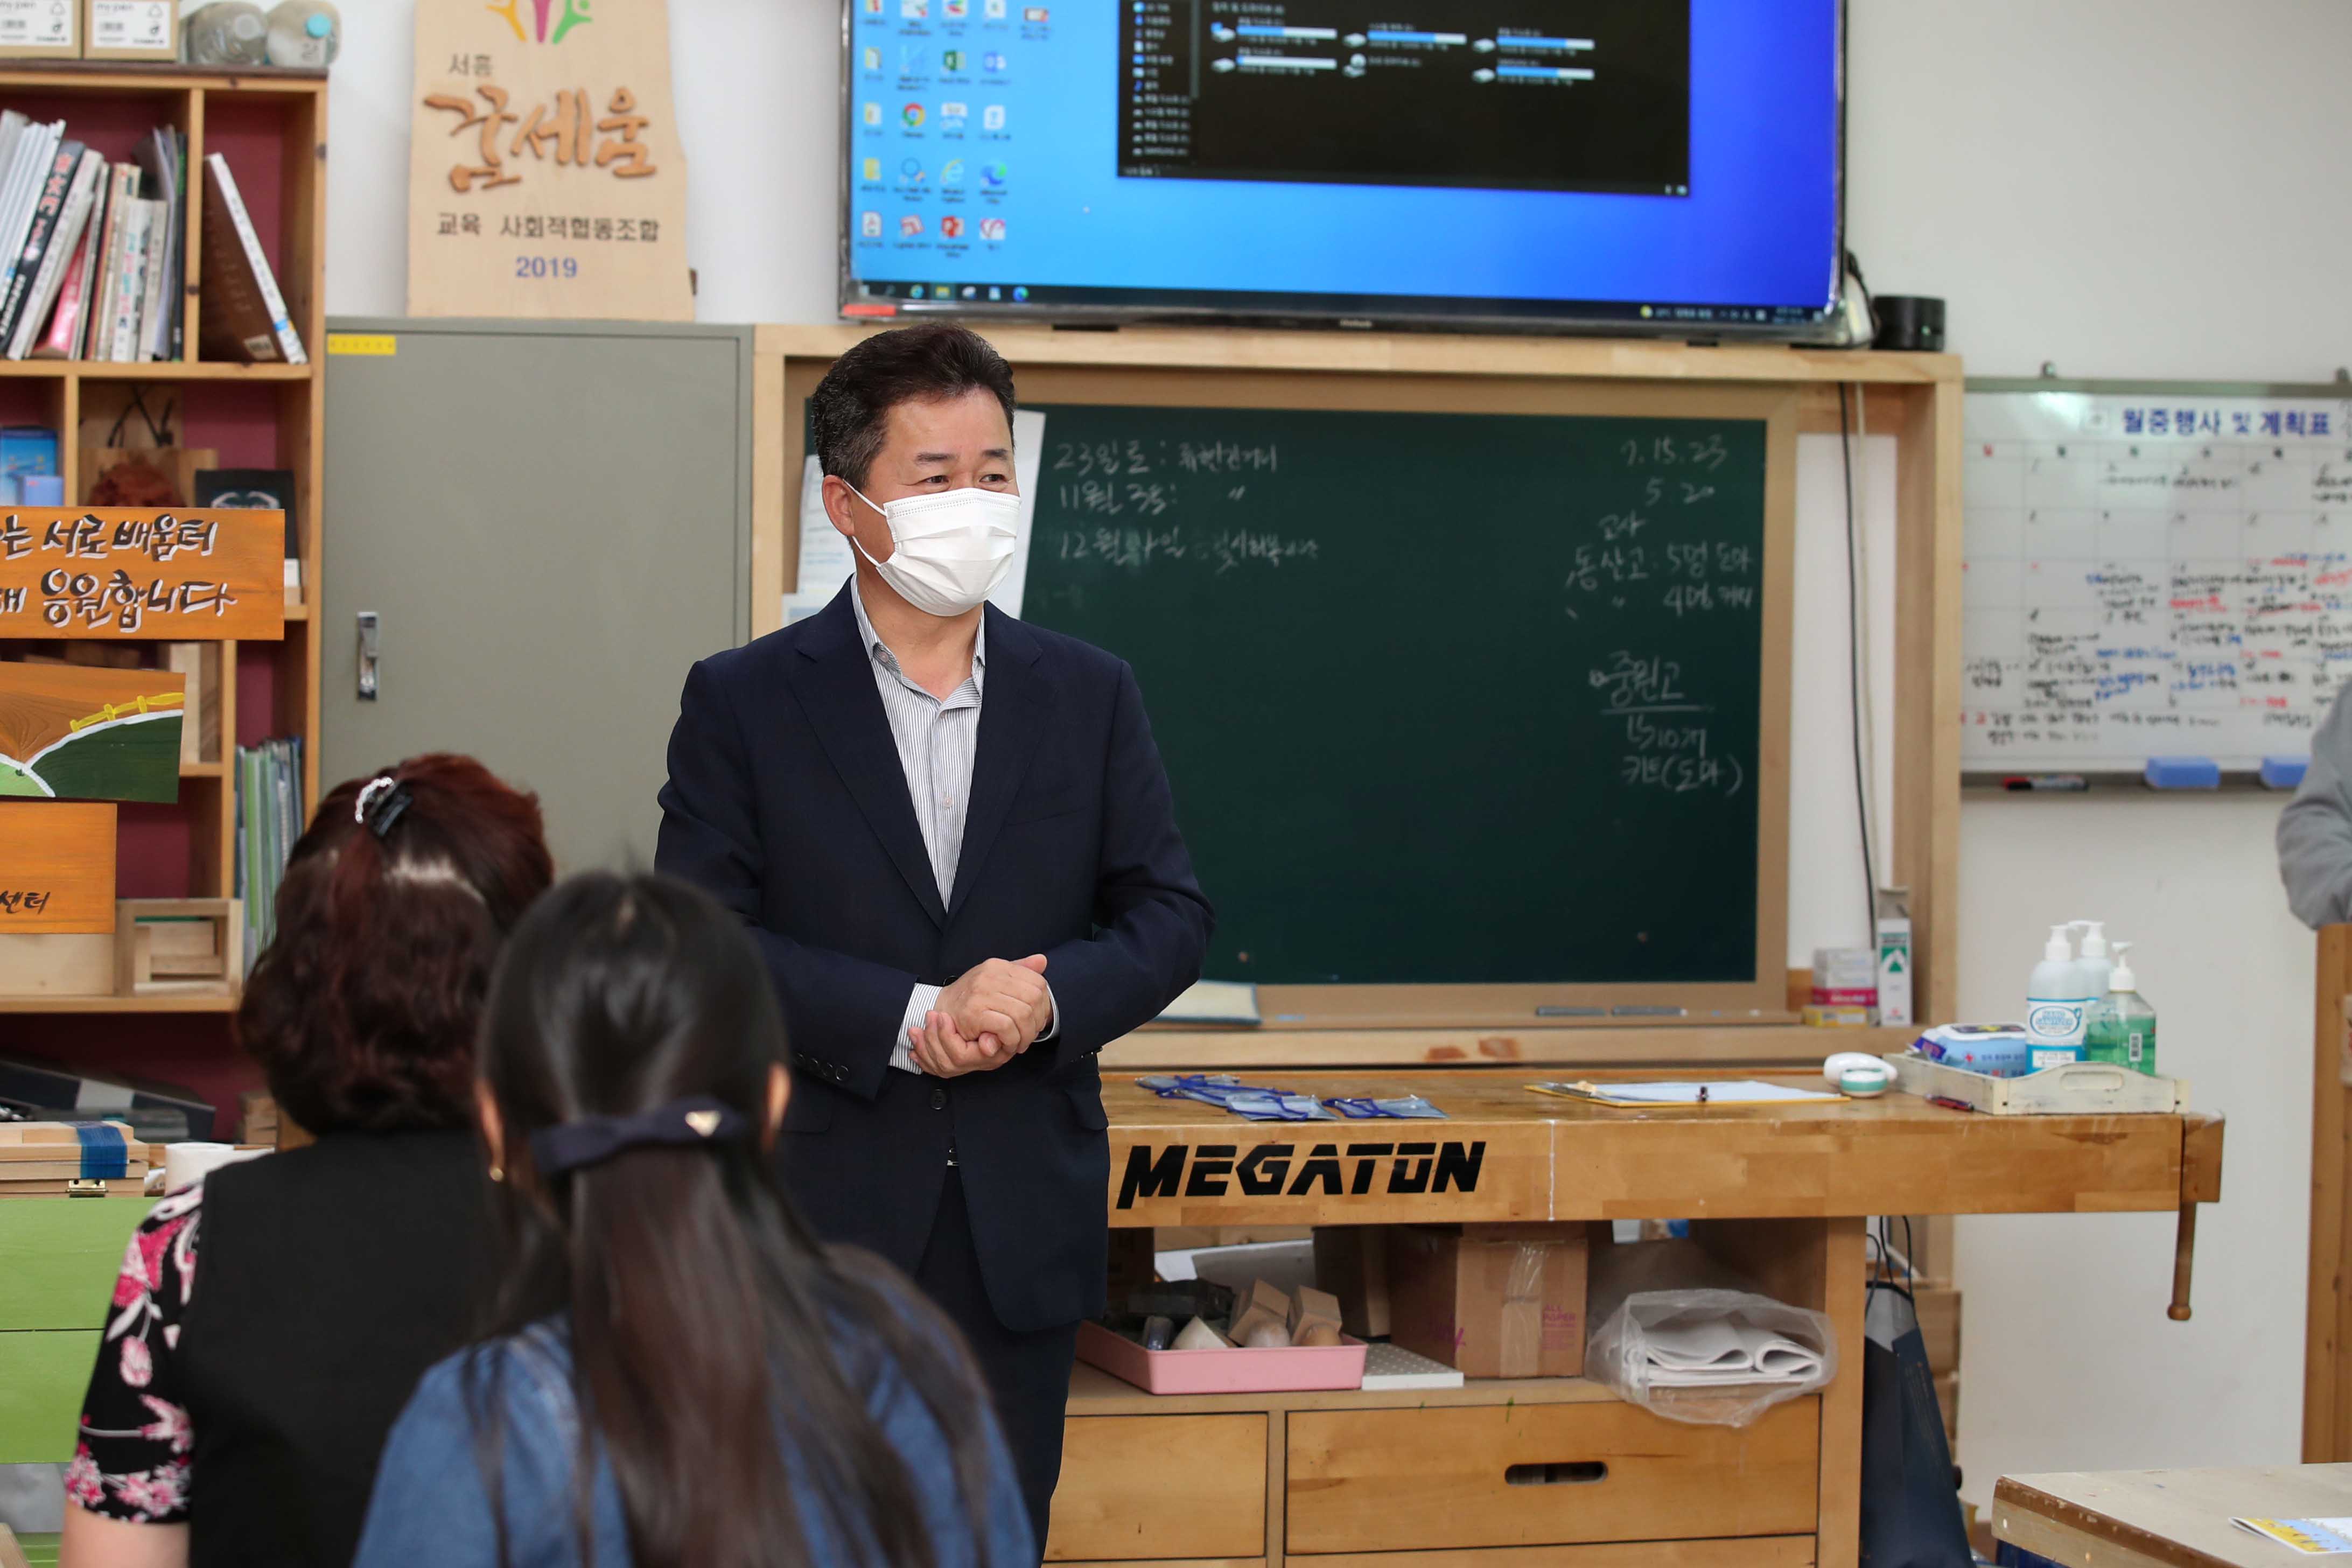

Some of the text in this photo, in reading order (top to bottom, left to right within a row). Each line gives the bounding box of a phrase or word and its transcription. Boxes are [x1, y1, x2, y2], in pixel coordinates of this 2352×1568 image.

[437, 213, 660, 242] 교육 사회적협동조합
[516, 256, 577, 278] 2019
[2123, 408, 2221, 436] 월중행사
[2260, 411, 2331, 436] 계획표
[41, 514, 107, 558] 서로
[112, 514, 218, 561] 배움터
[41, 568, 238, 633] 응원합니다
[1116, 1141, 1487, 1209] MEGATON
